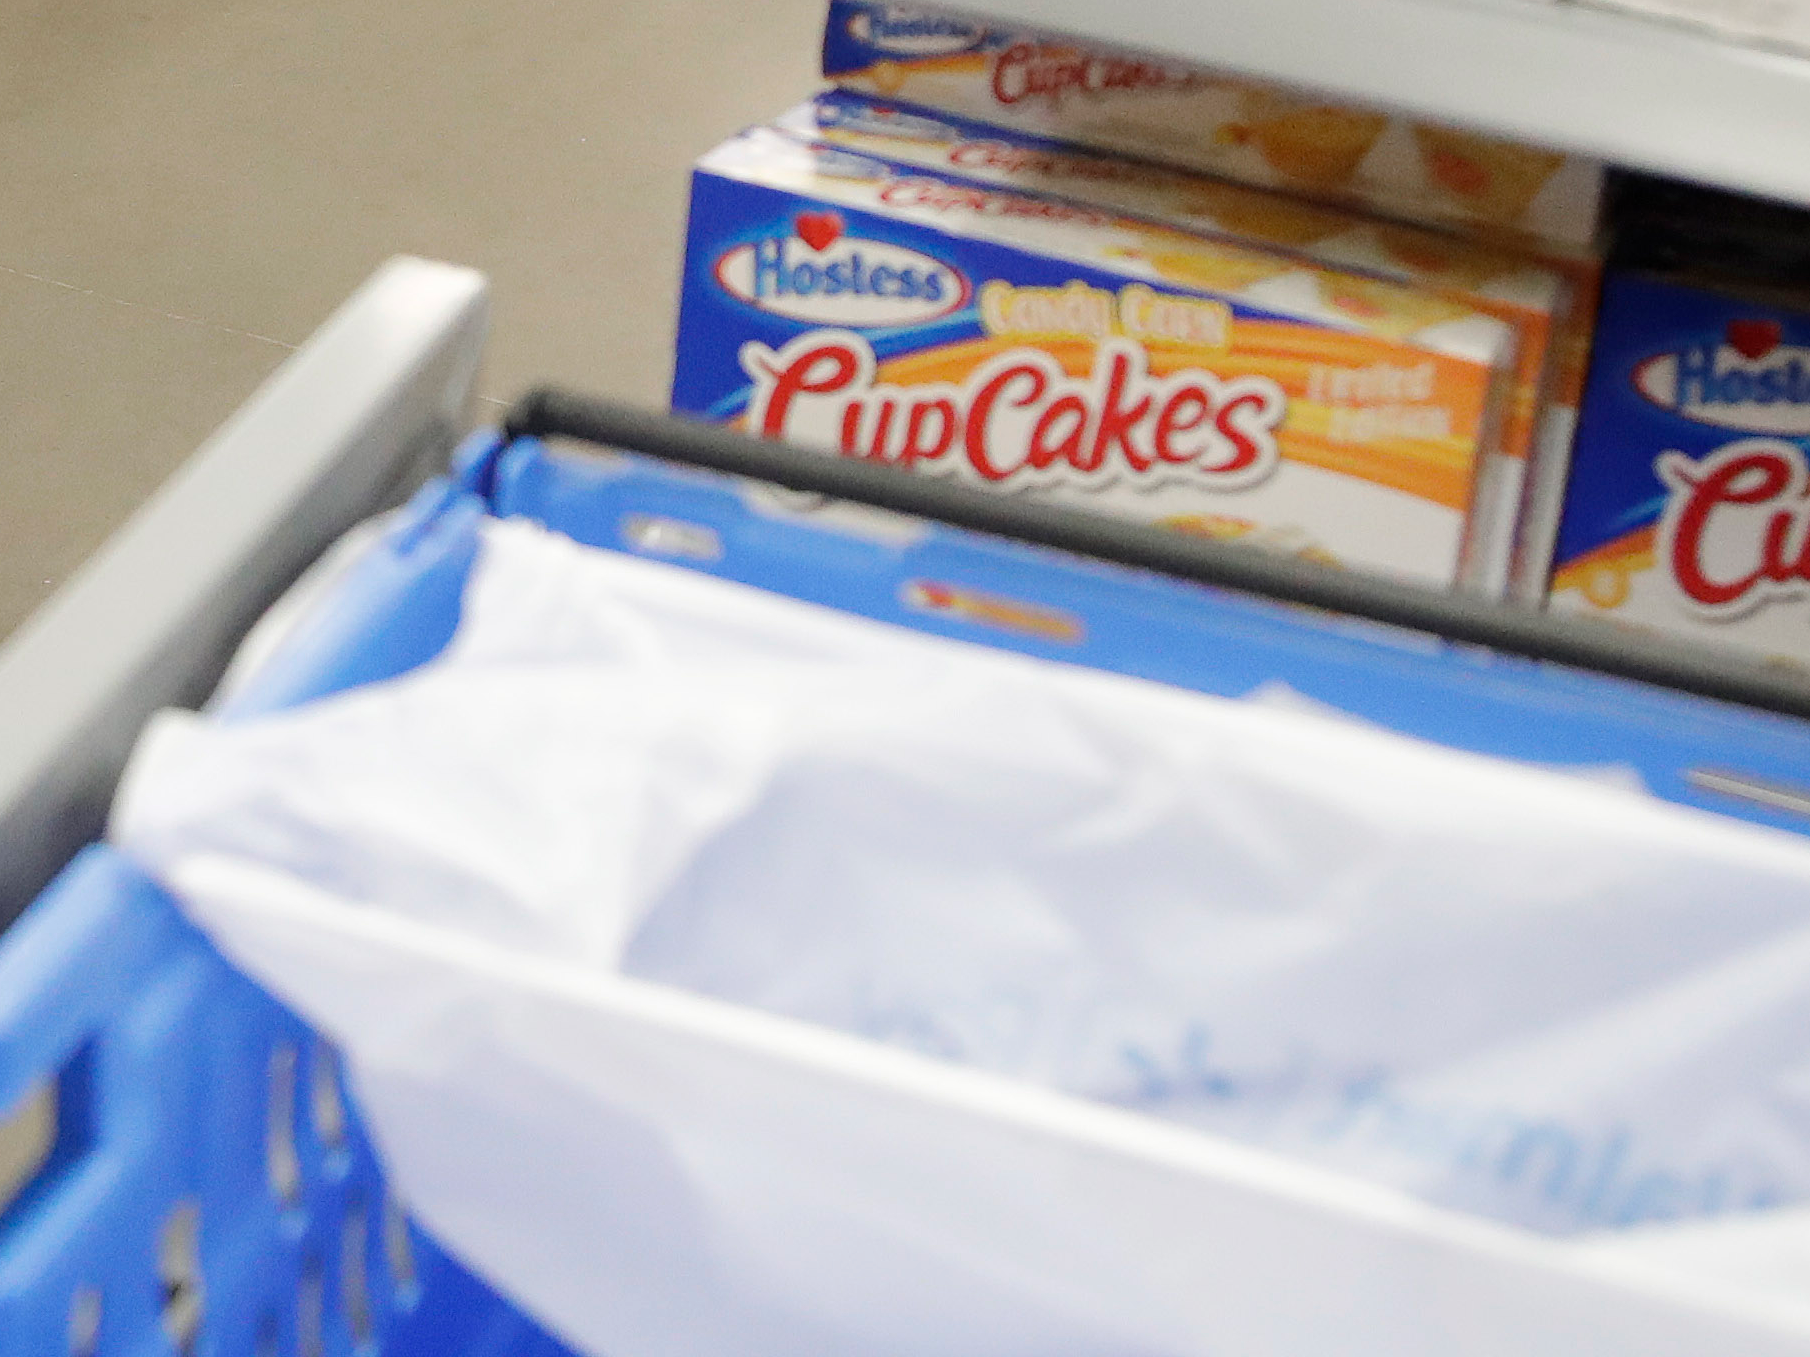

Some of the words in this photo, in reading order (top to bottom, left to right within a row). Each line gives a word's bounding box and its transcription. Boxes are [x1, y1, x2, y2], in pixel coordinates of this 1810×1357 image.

[868, 8, 987, 41] Hostess
[754, 248, 942, 306] Hostess
[987, 283, 1115, 338] Candy
[1124, 292, 1230, 347] Corn
